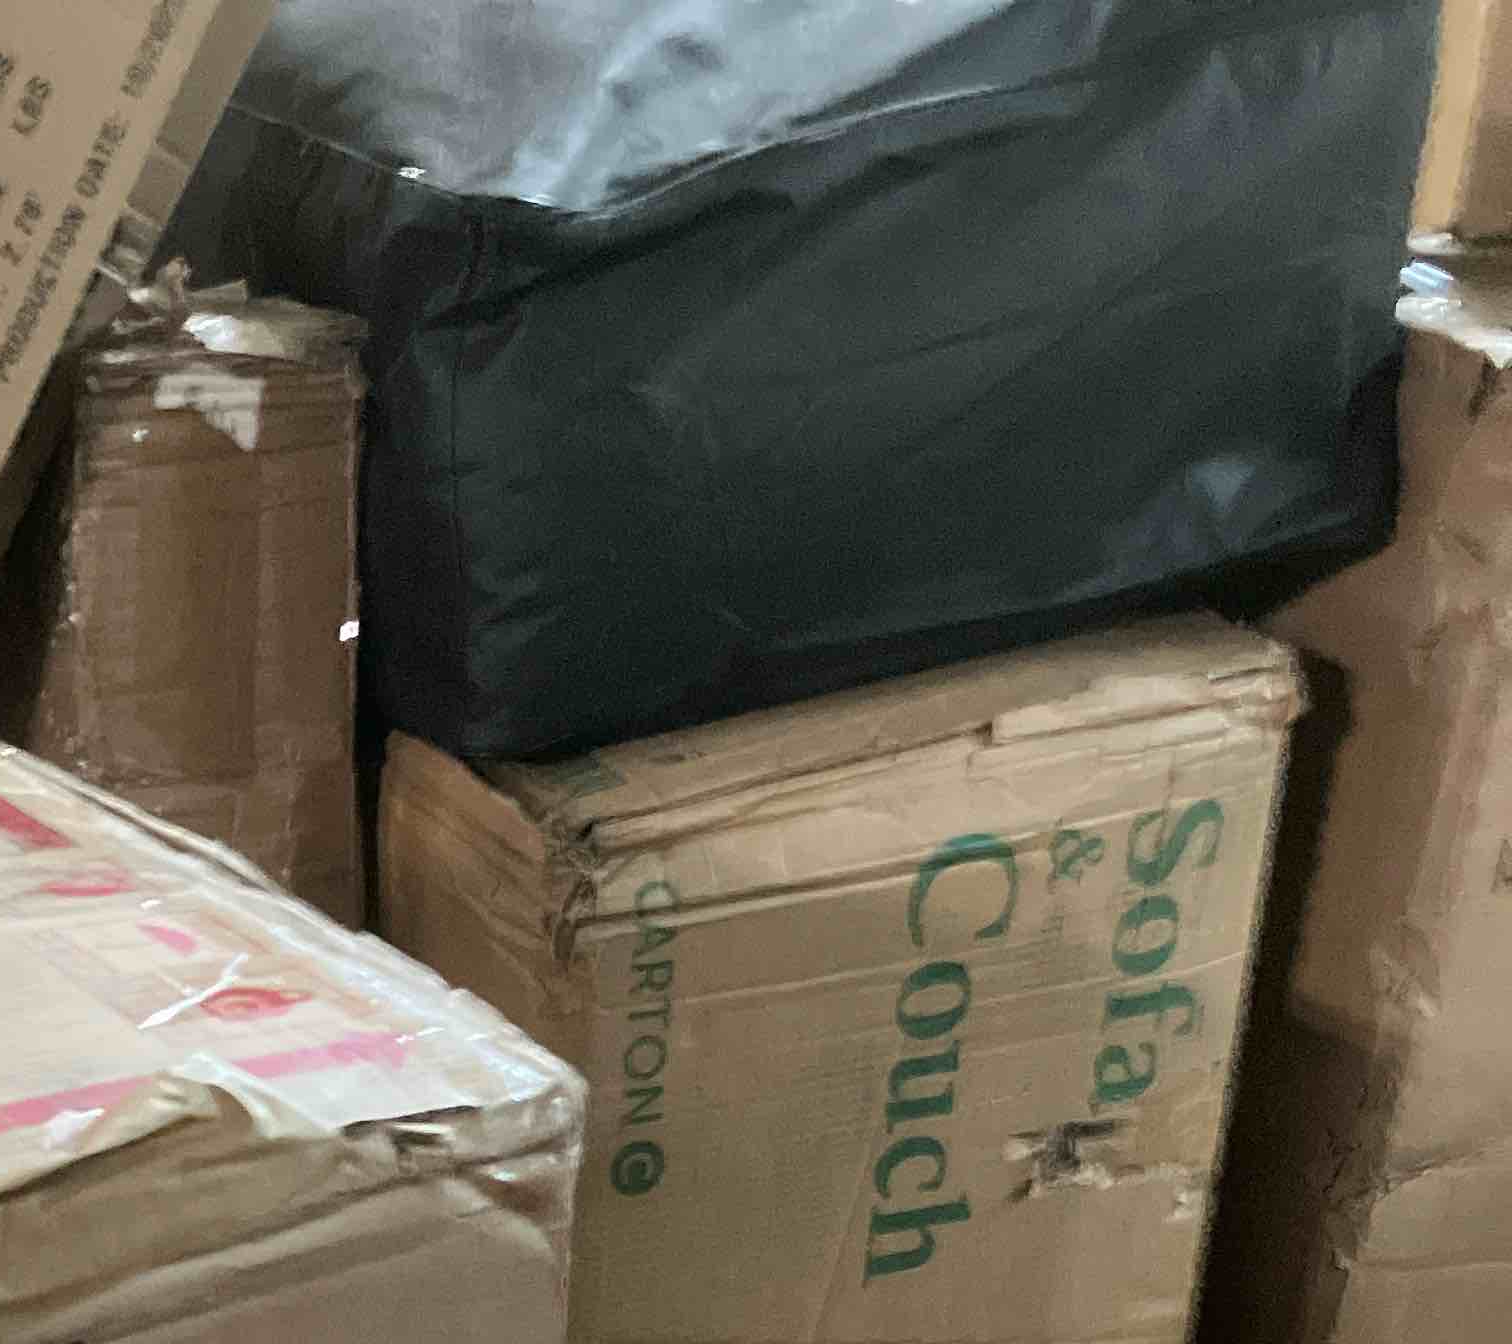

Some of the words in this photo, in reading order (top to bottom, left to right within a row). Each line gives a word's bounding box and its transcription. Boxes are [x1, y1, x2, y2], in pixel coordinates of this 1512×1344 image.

[10, 75, 53, 136] LBS
[1047, 820, 1106, 892] &
[1090, 799, 1225, 1113] Sofa
[618, 879, 683, 1129] CARTON
[863, 831, 1019, 1286] Couch
